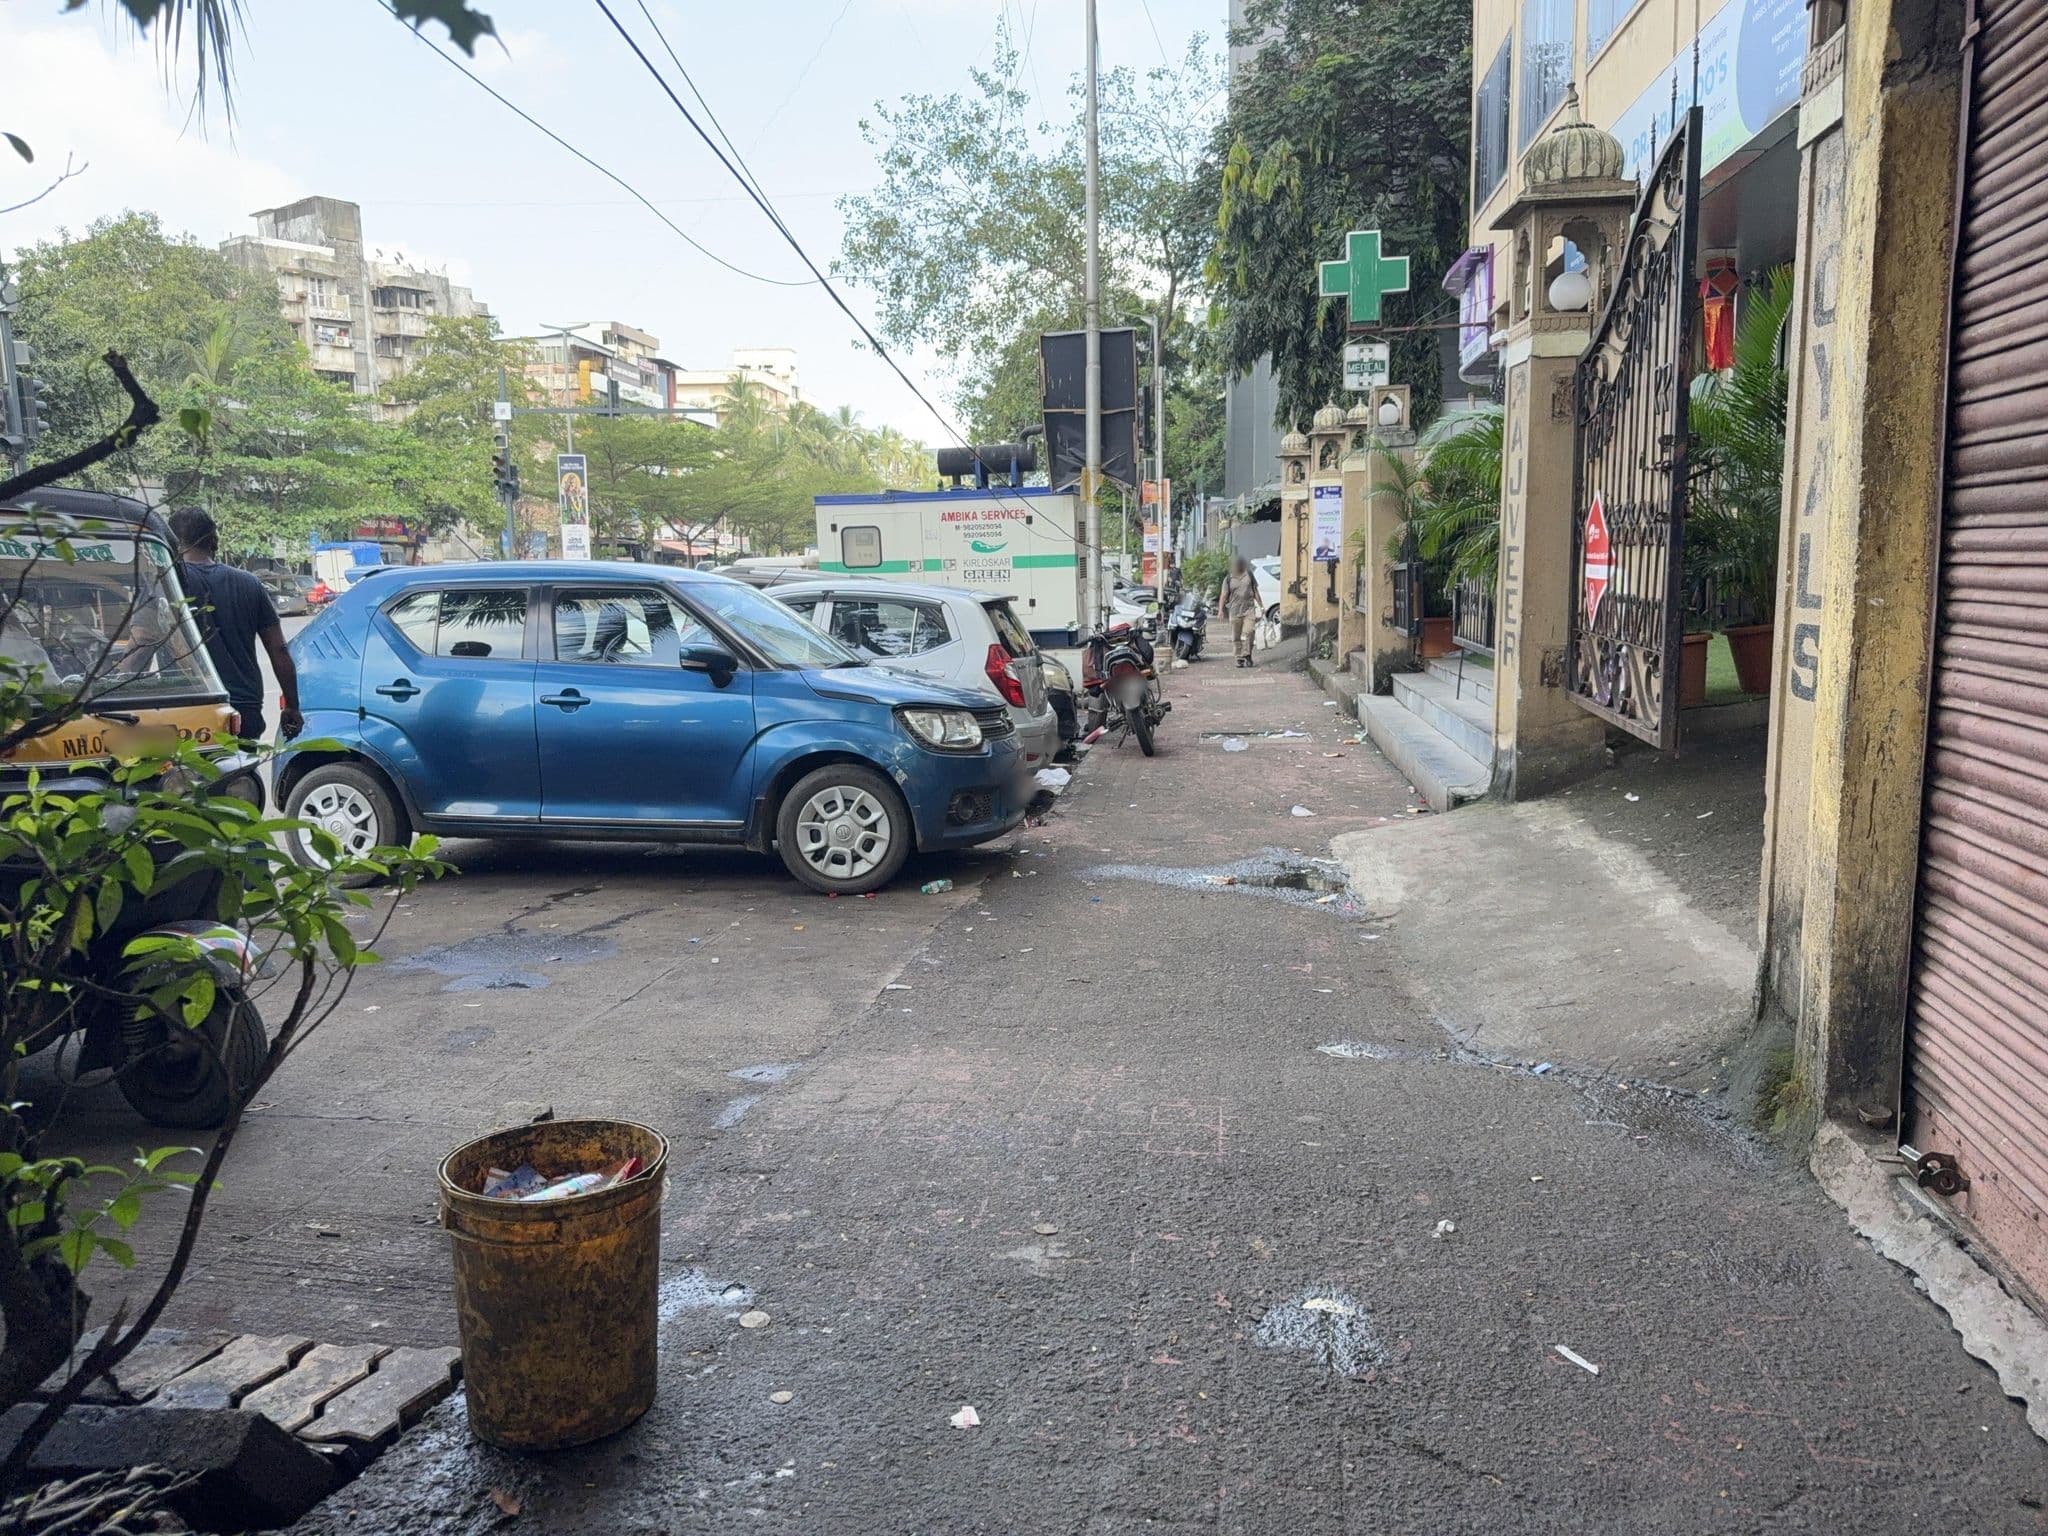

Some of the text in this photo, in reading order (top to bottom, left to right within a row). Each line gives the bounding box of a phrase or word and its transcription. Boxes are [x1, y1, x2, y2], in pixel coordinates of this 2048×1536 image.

[1347, 361, 1385, 372] MEDICAL
[941, 509, 1026, 522] AMBIKA SERVICES
[963, 558, 1010, 567] KIRLOSKAR
[964, 570, 1010, 579] GREEN
